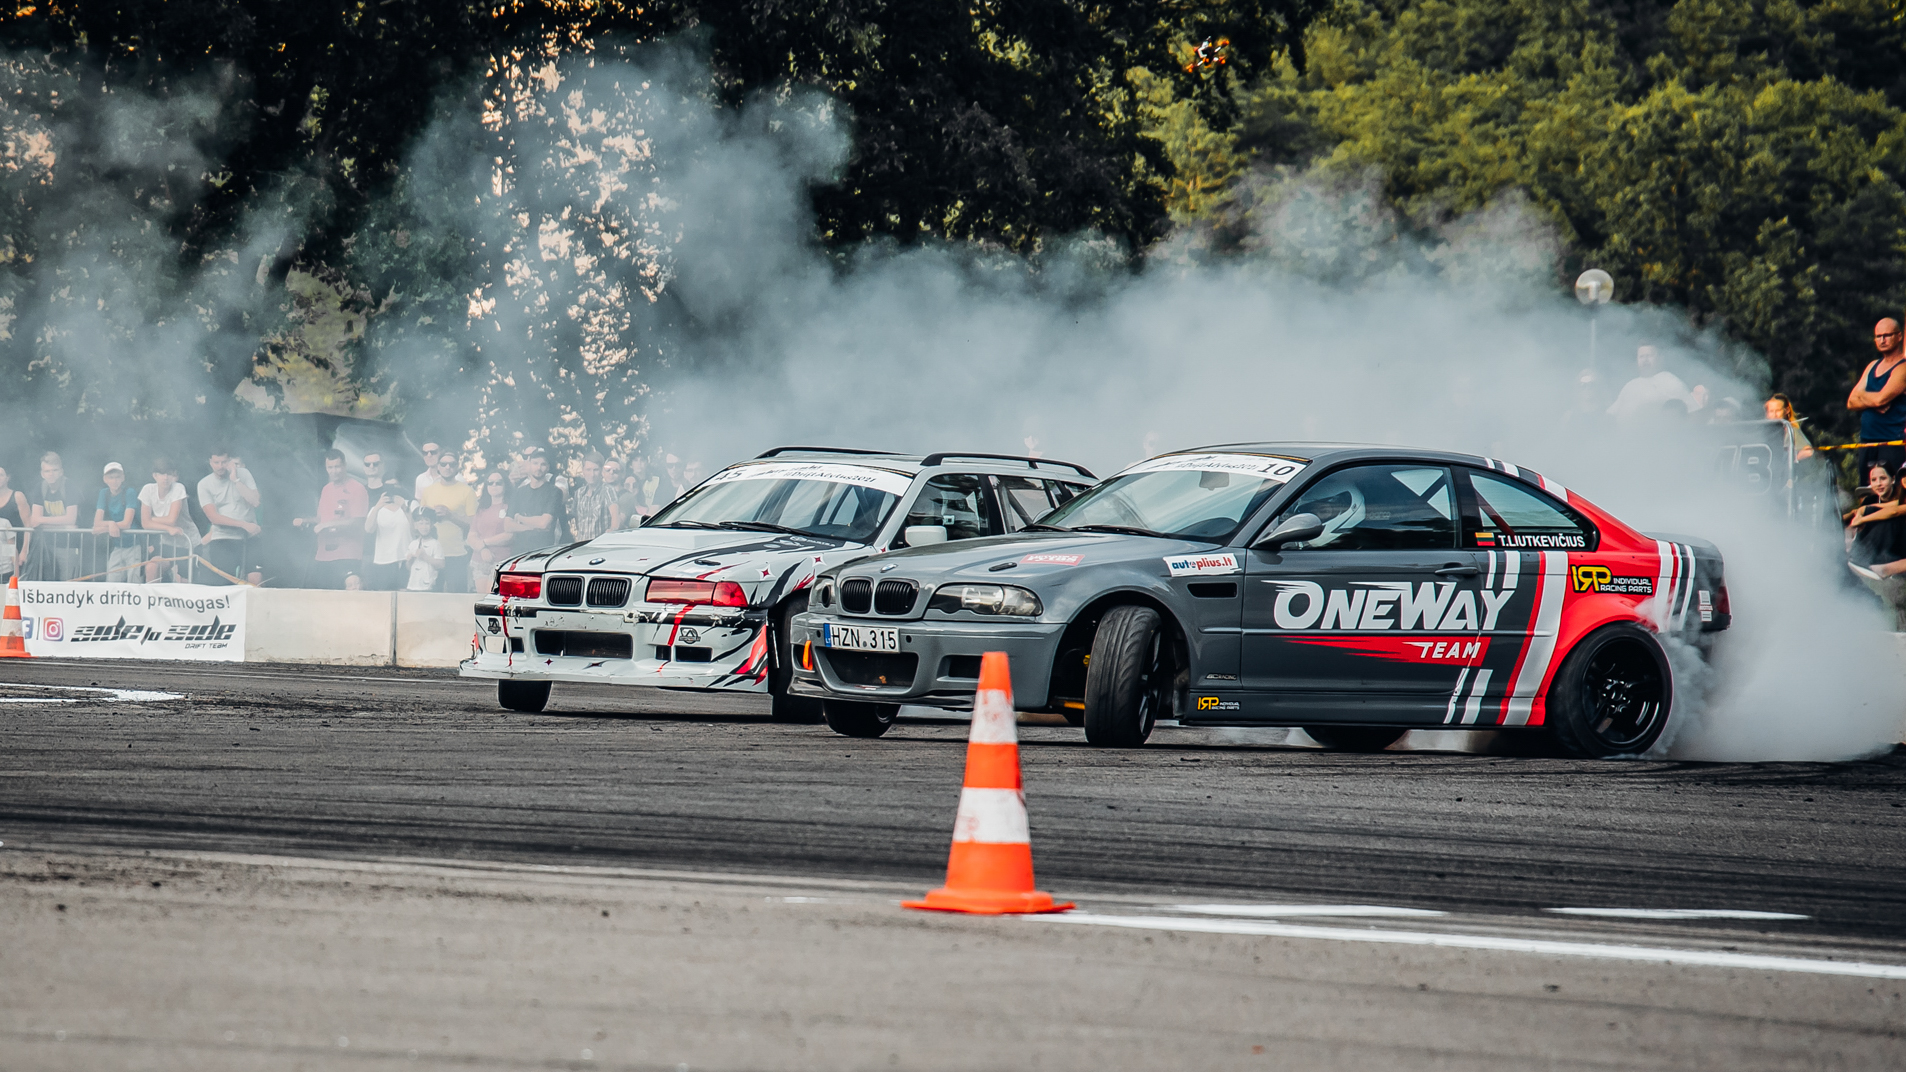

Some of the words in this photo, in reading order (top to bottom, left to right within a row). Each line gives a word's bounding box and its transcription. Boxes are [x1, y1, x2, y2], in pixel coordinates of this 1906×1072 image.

[1257, 463, 1296, 476] 10
[1497, 533, 1586, 548] T.LIUTKEVIČIUS
[1171, 557, 1233, 570] autoplius.lt
[1613, 577, 1652, 586] INDIVIDUAL
[21, 589, 95, 609] Išbandyk
[99, 590, 142, 606] drifto
[147, 594, 231, 613] pramogas!
[1402, 641, 1481, 659] TEAM
